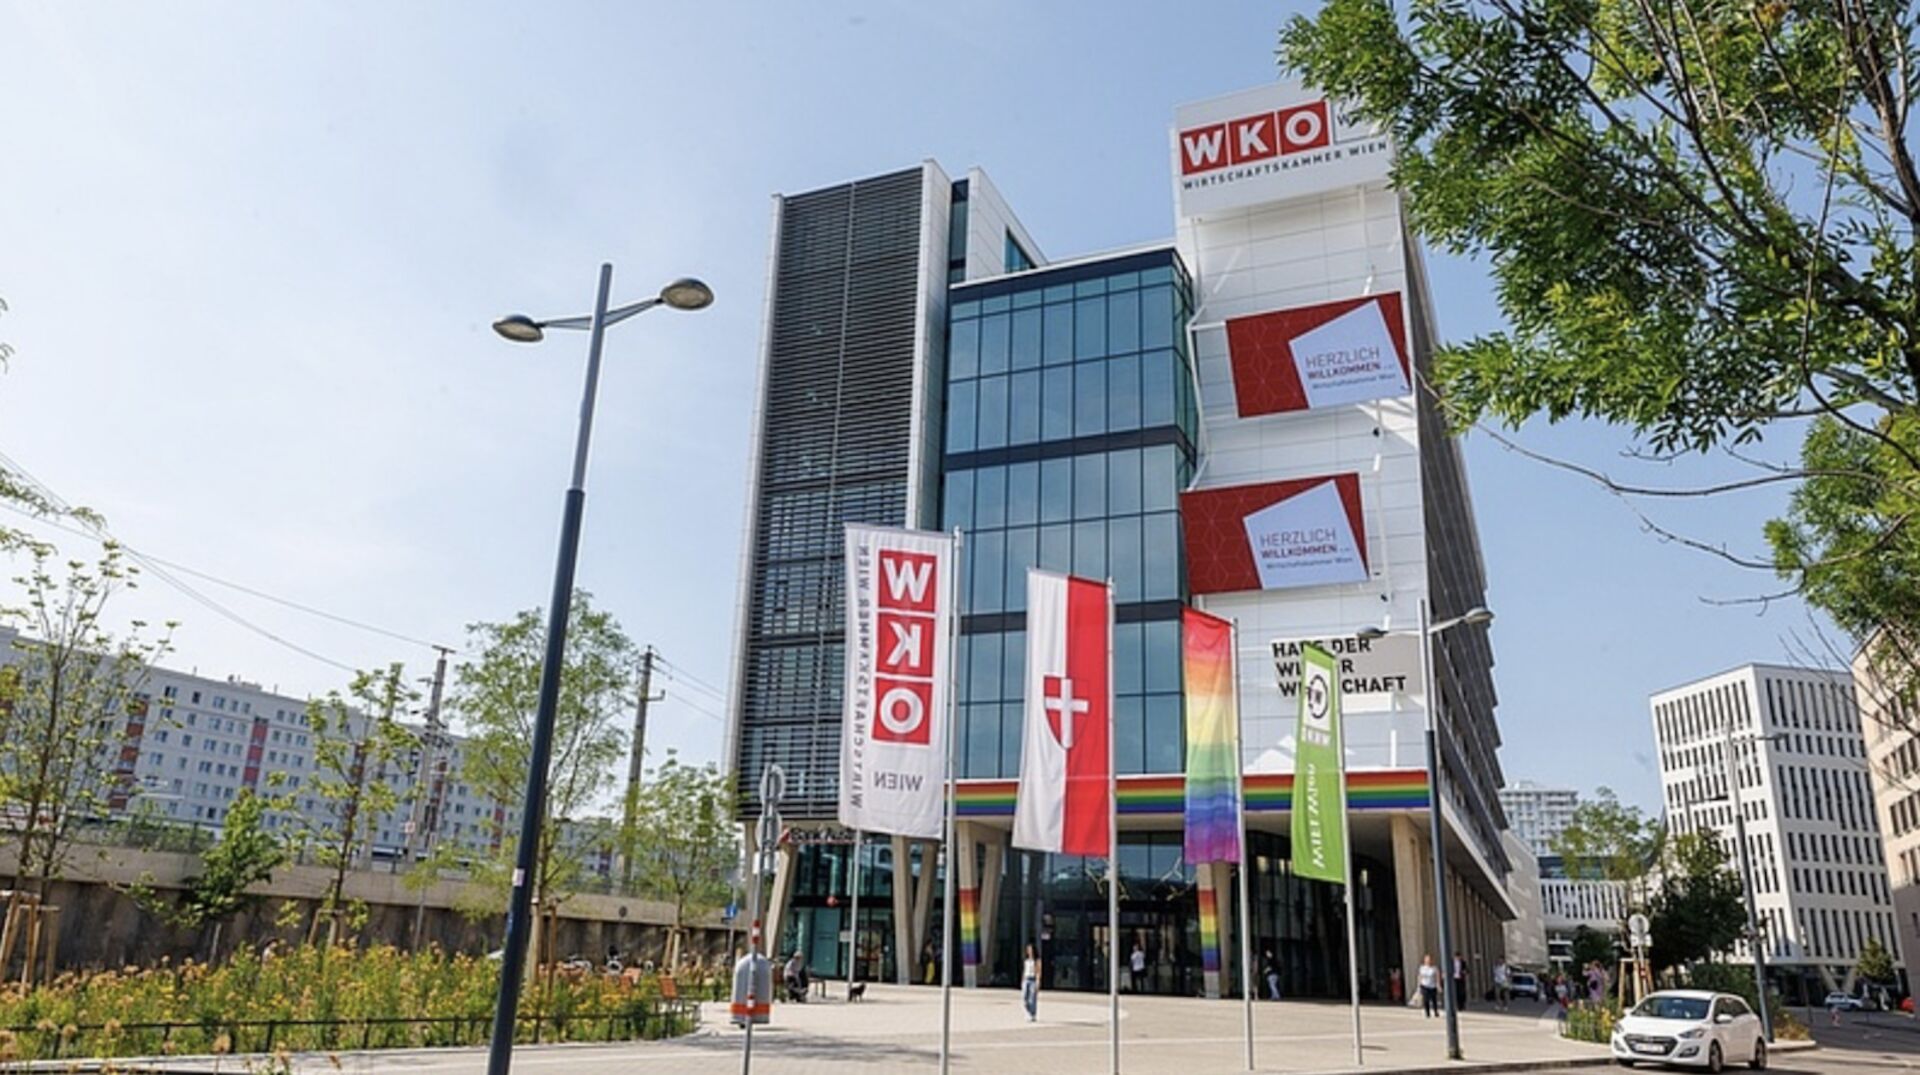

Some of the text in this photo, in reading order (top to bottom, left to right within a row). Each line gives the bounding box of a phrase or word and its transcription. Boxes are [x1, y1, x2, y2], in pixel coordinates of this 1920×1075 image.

[1183, 111, 1321, 167] WKO
[1183, 141, 1387, 190] WIRTSCHAFTSKAMMER WIEN
[1305, 346, 1381, 368] HERZLICH
[1307, 361, 1381, 379] WILLKOMMEN
[1260, 527, 1337, 547] HERZLICH
[1262, 543, 1338, 559] WILLKOMMEN
[1331, 637, 1371, 653] DER
[1276, 660, 1354, 677] WIR
[1279, 676, 1406, 697] WICHAFT
